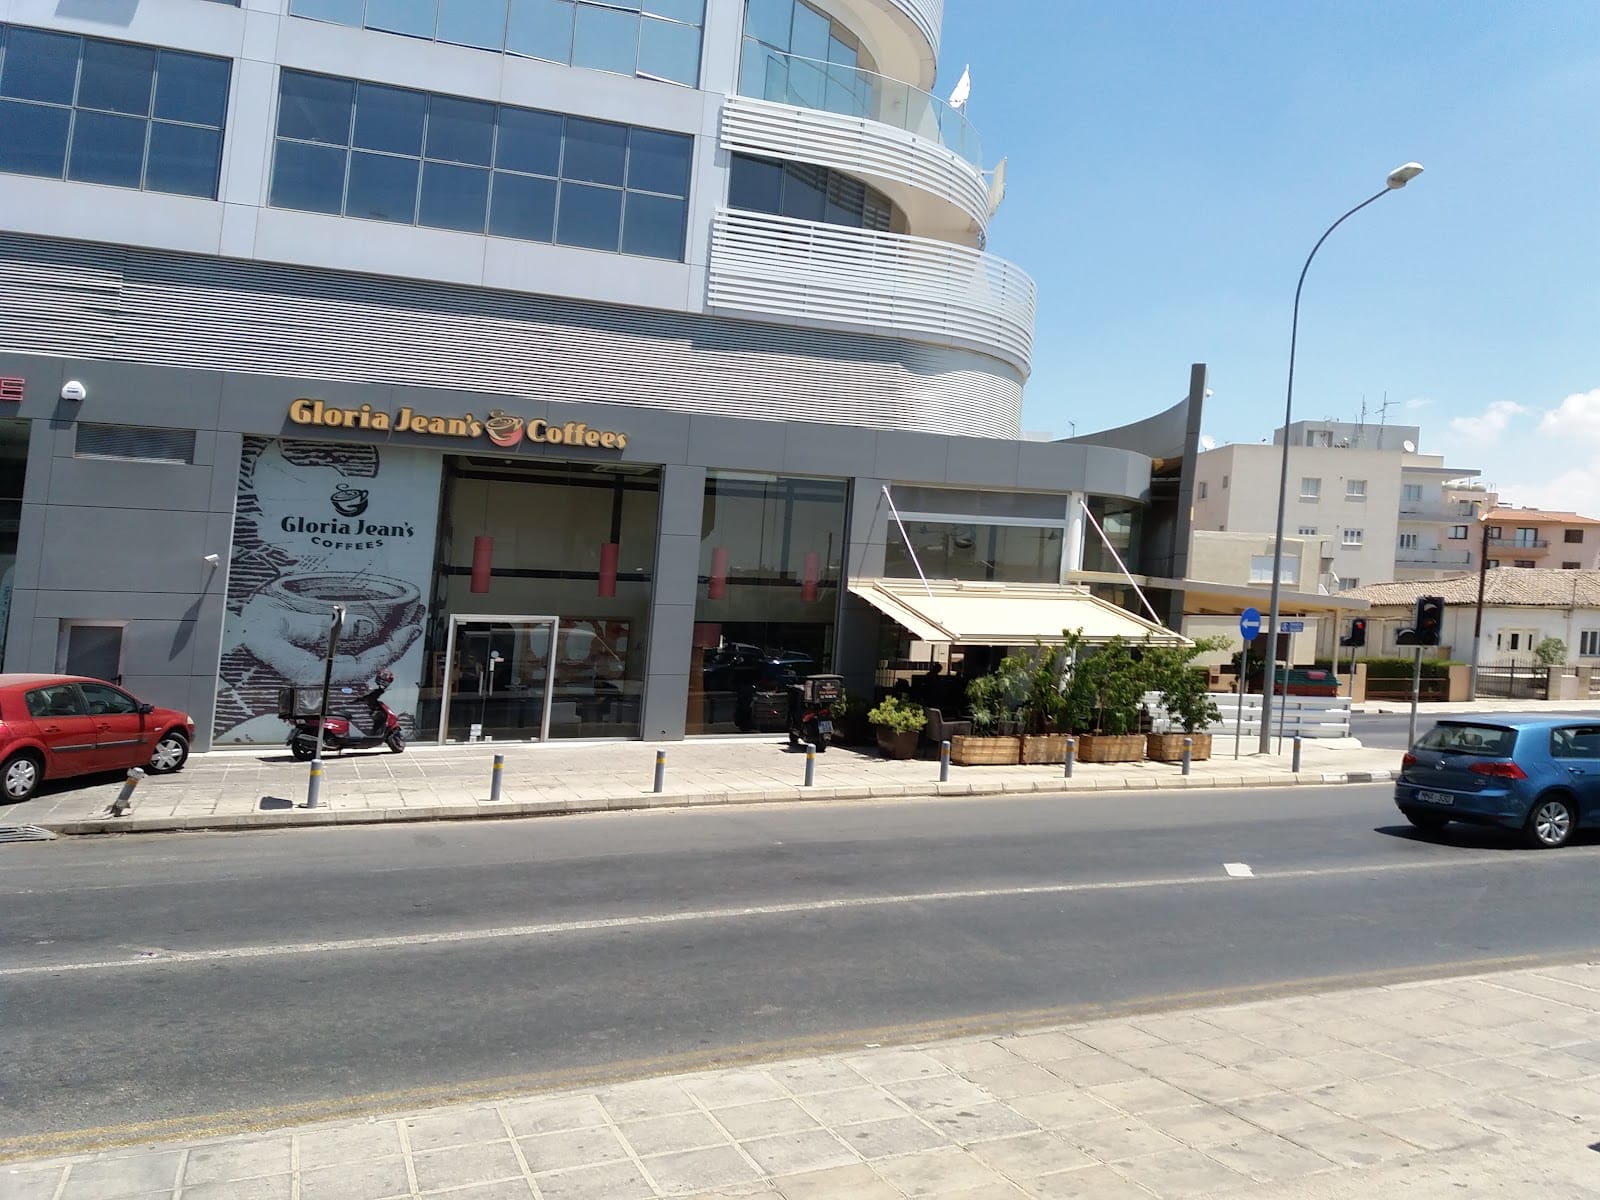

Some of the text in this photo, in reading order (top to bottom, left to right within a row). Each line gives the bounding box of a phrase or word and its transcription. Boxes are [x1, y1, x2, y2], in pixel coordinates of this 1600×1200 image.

[290, 399, 626, 449] Gloria Jean's Coffees
[281, 515, 415, 538] Gloria Jean's
[310, 536, 384, 550] COFFEES
